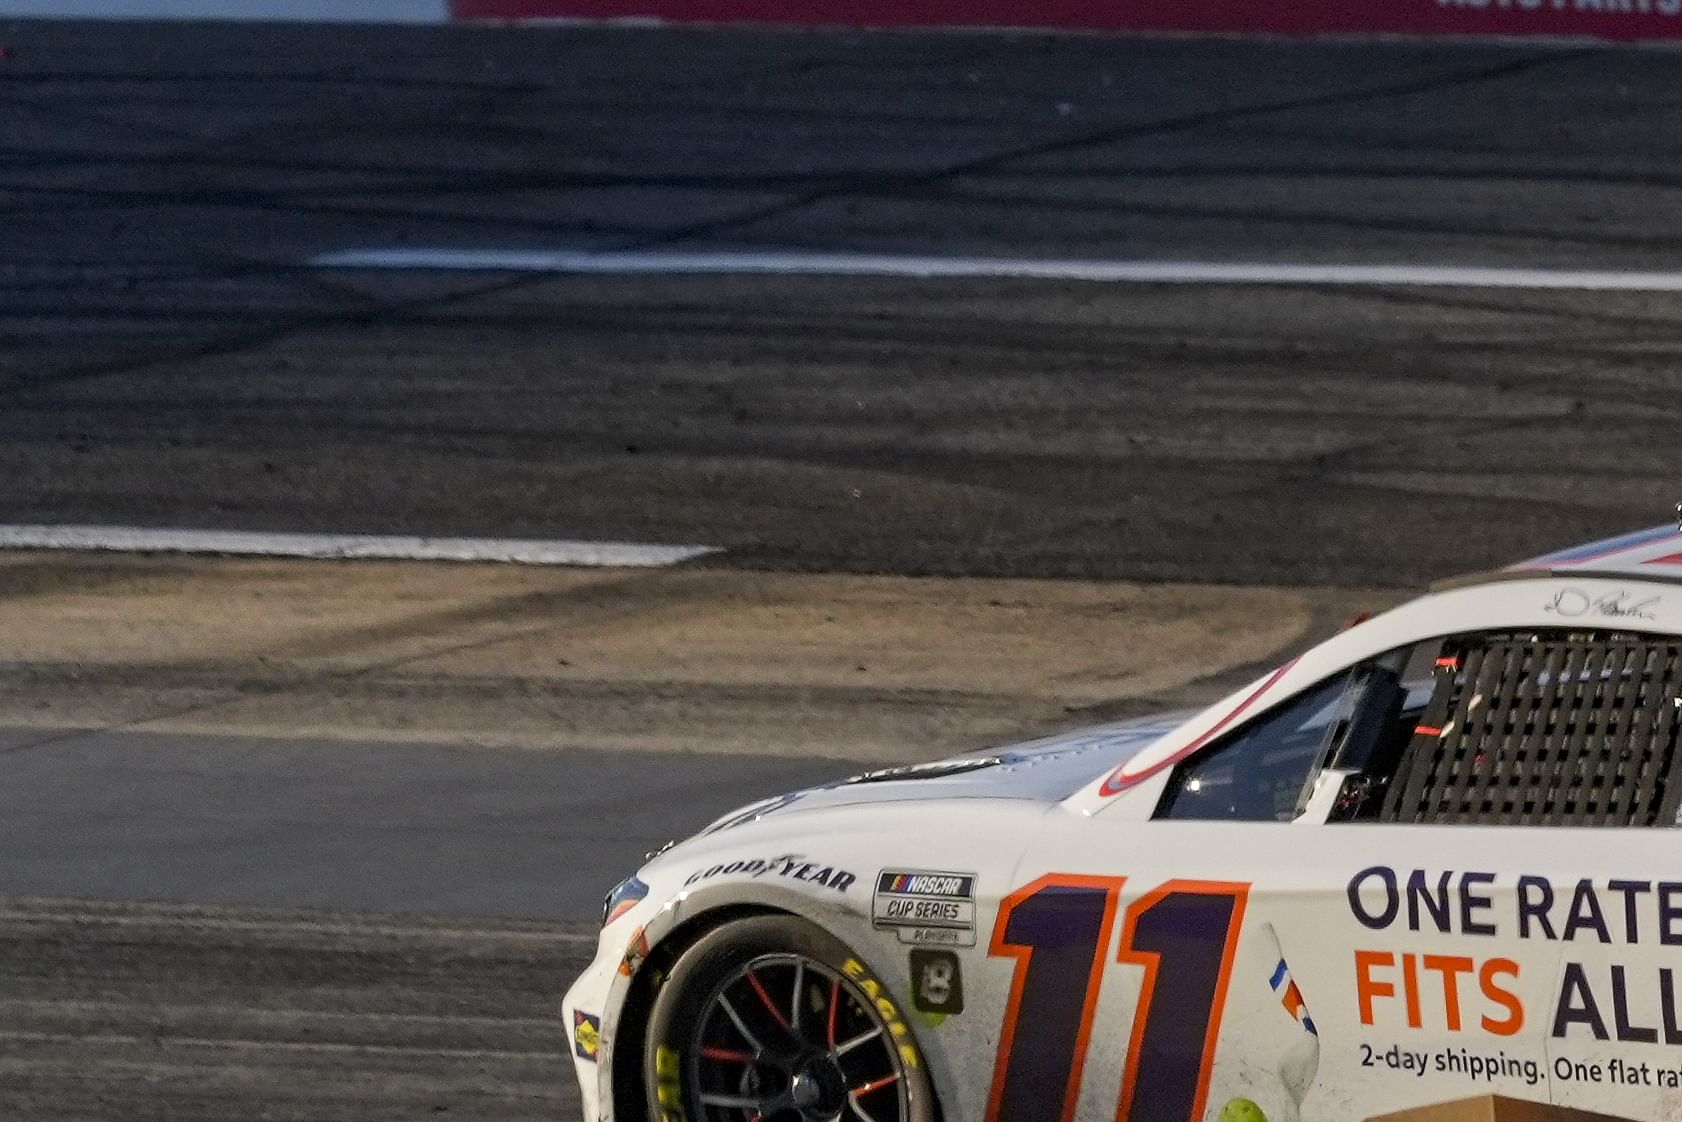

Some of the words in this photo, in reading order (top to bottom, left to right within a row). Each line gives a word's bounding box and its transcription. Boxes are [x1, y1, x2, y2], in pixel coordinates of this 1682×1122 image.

[684, 853, 857, 893] GOODYEAR
[907, 876, 963, 895] NASCAR
[887, 900, 914, 917] CUP
[915, 901, 960, 918] SERIES
[1347, 865, 1497, 937] ONE
[1354, 950, 1525, 1037] FITS
[1360, 1044, 1429, 1076] 2-day
[1434, 1048, 1545, 1086] shipping.
[1554, 1058, 1602, 1083] One
[1608, 1059, 1649, 1086] flat
